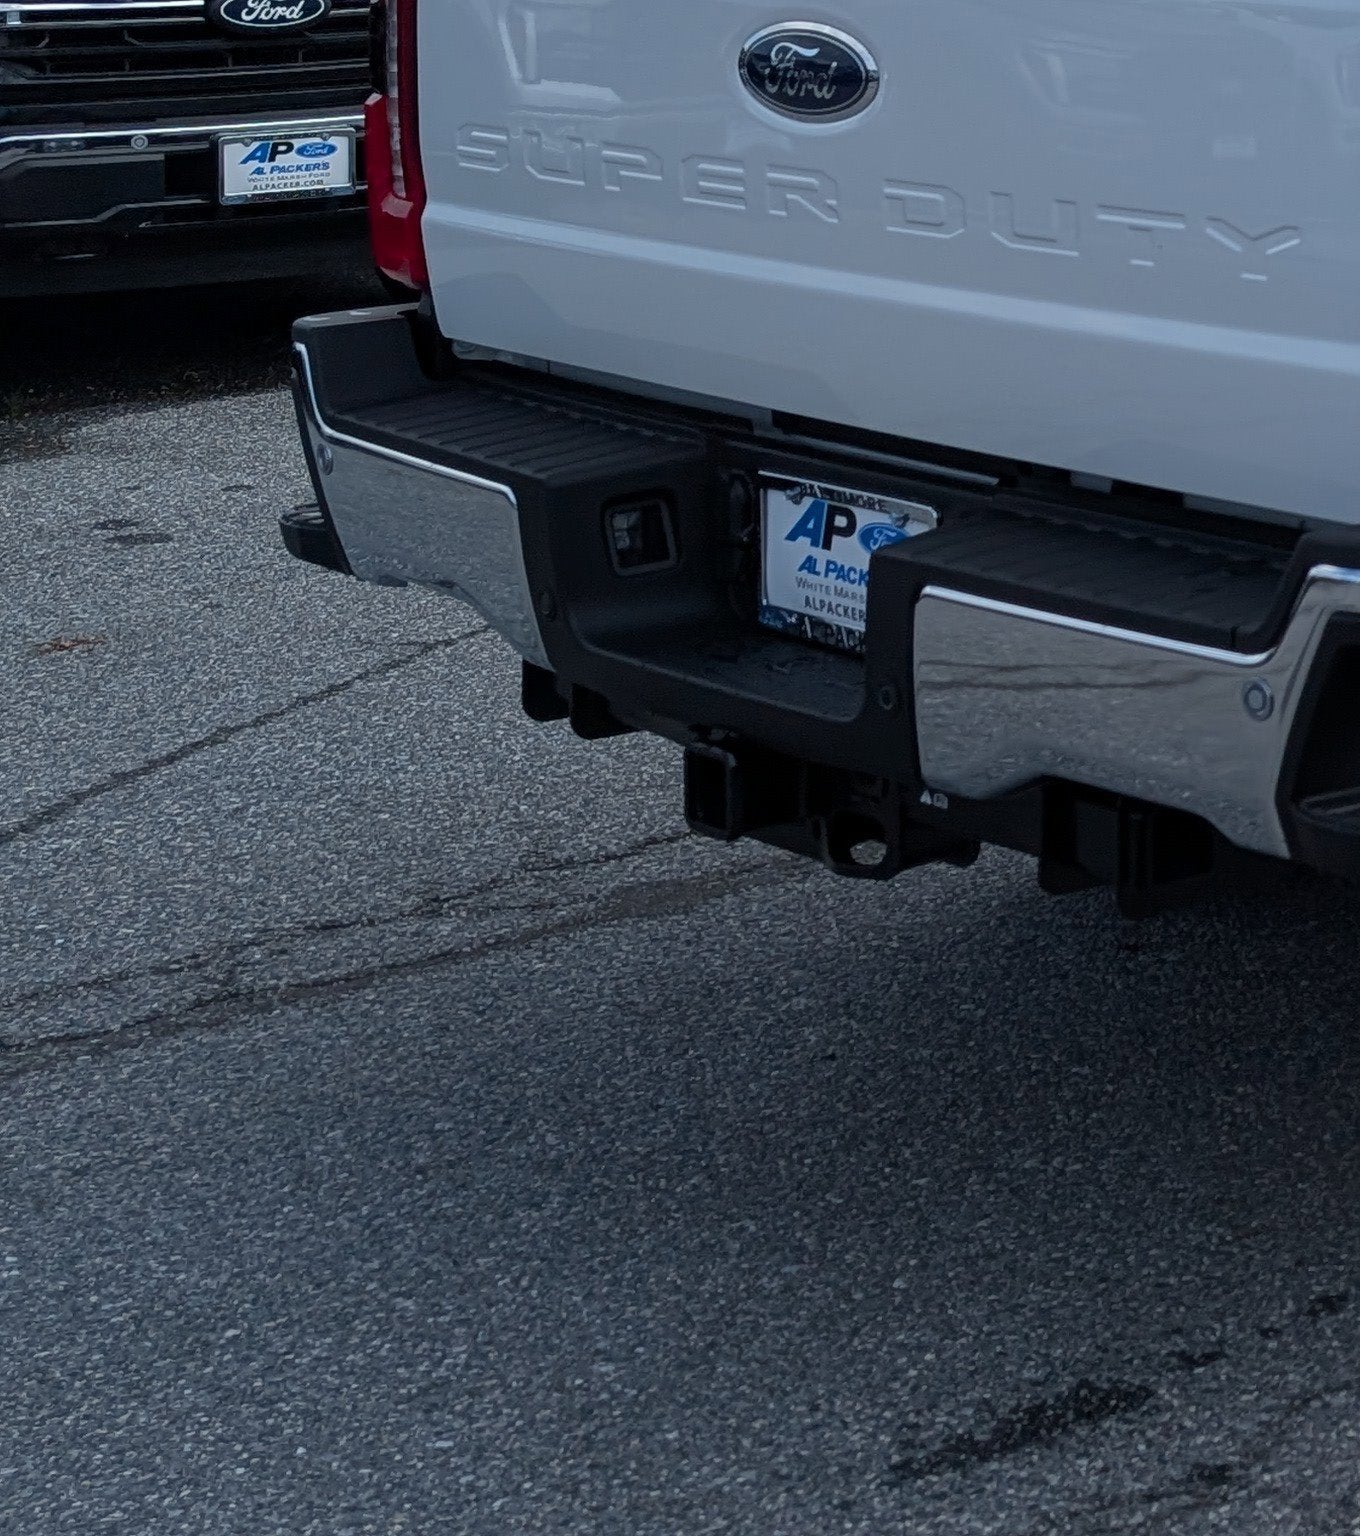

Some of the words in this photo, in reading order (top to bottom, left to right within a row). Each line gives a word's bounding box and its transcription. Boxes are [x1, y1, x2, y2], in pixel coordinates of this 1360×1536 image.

[764, 41, 837, 100] Ford
[238, 140, 295, 165] AP
[456, 122, 840, 224] SUPER
[882, 178, 1301, 282] DUTY
[784, 498, 858, 552] AP
[797, 553, 821, 577] AL
[824, 559, 870, 588] PACK
[804, 595, 867, 623] ALPACKER
[834, 584, 866, 605] MARS
